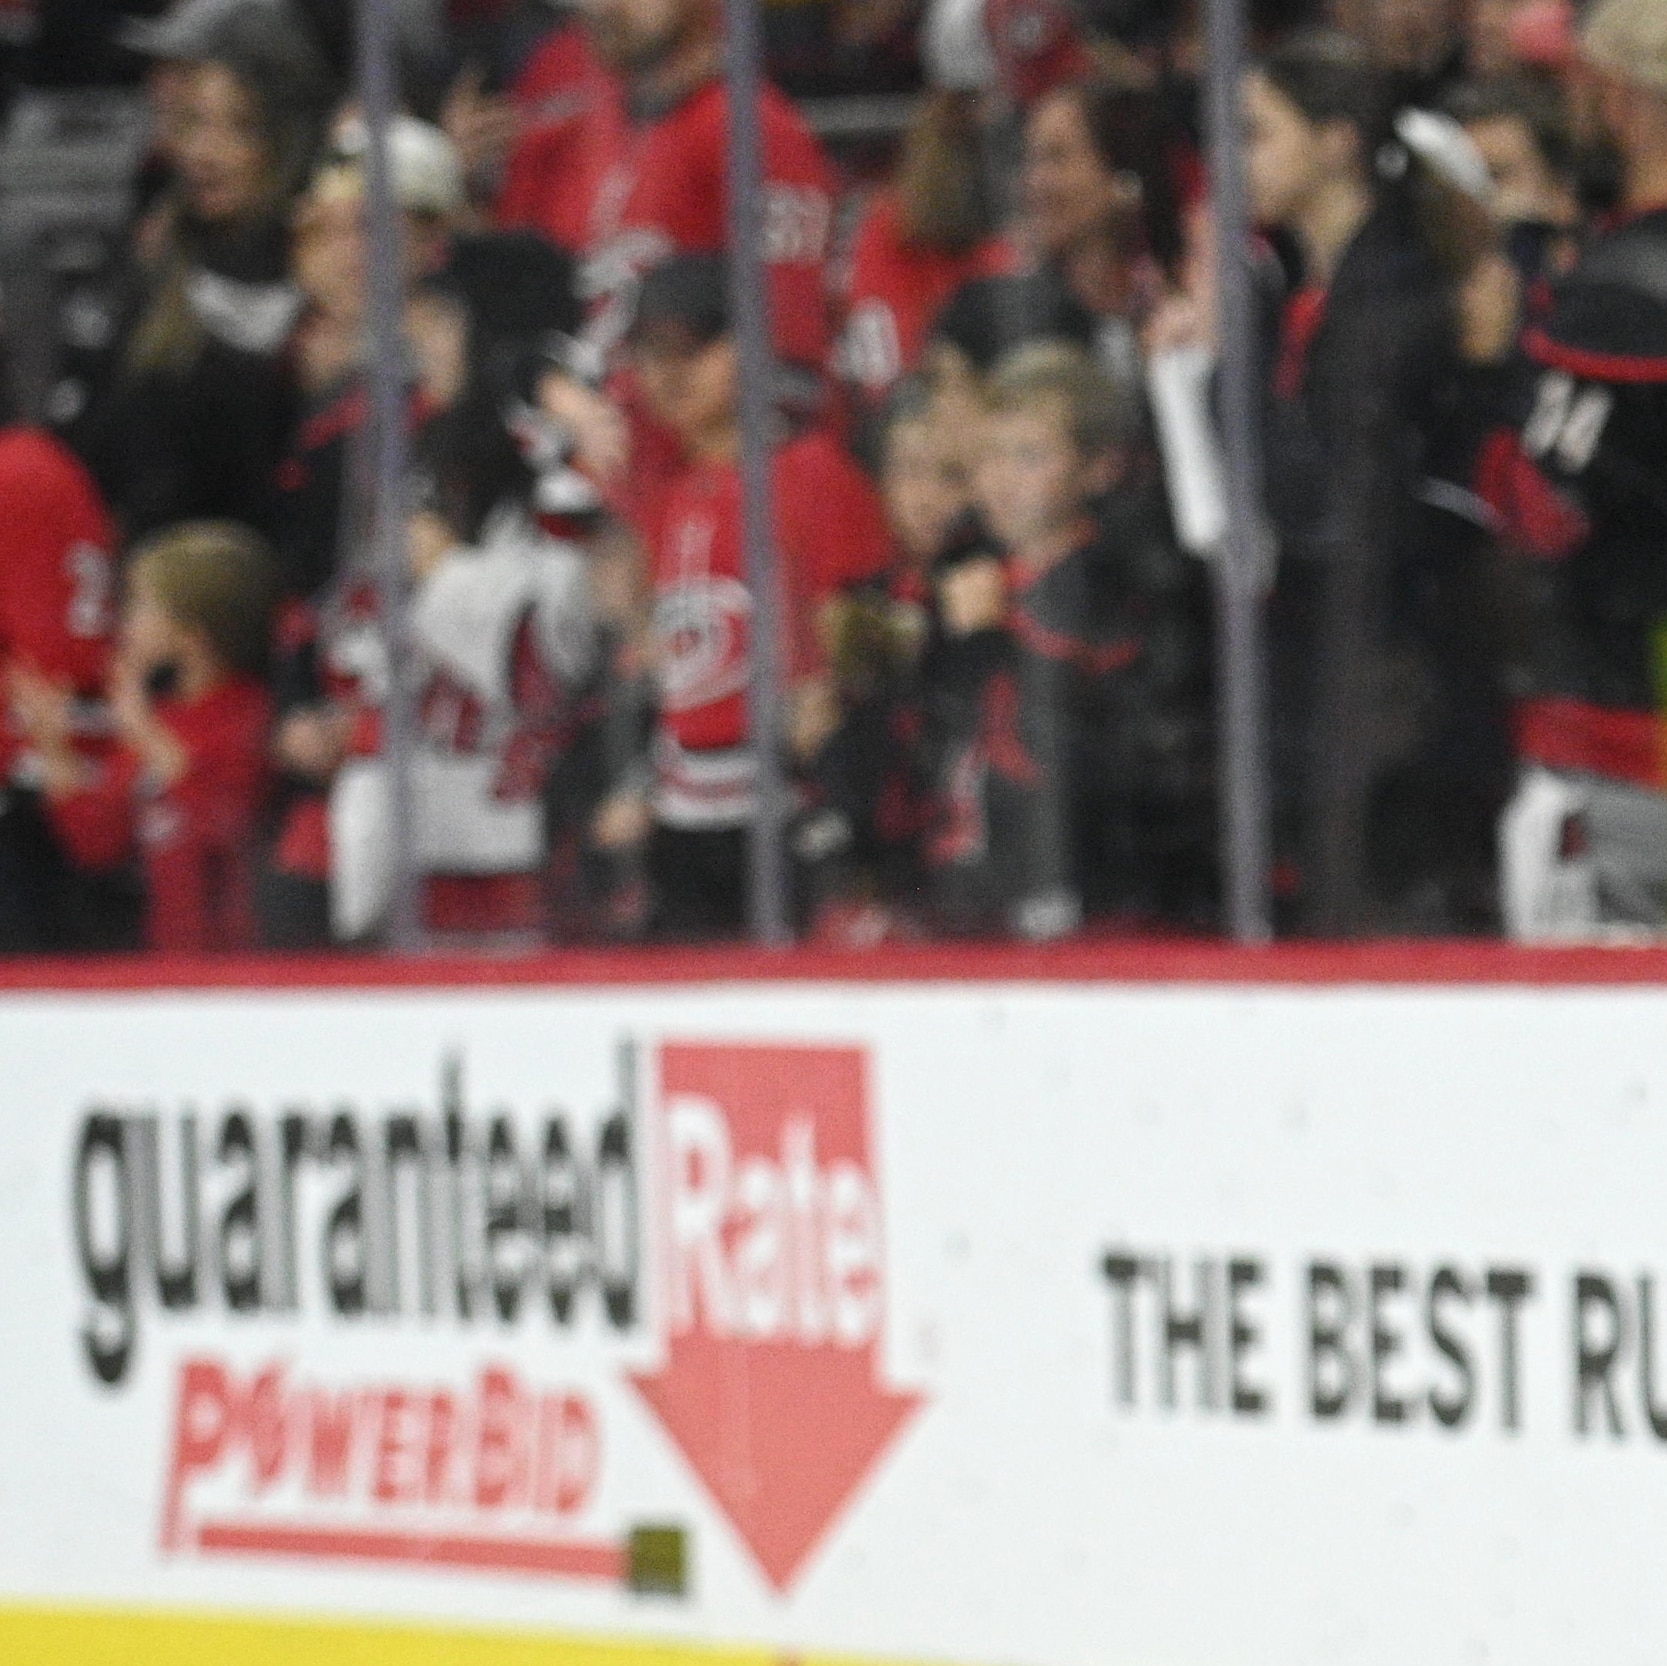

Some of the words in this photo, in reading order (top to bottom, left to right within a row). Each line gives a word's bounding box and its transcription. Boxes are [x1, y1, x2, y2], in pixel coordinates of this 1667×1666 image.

[72, 1035, 642, 1388] guaranteed
[664, 1097, 886, 1347] Rate
[1100, 1248, 1270, 1418] THE
[1304, 1259, 1536, 1432] BEST
